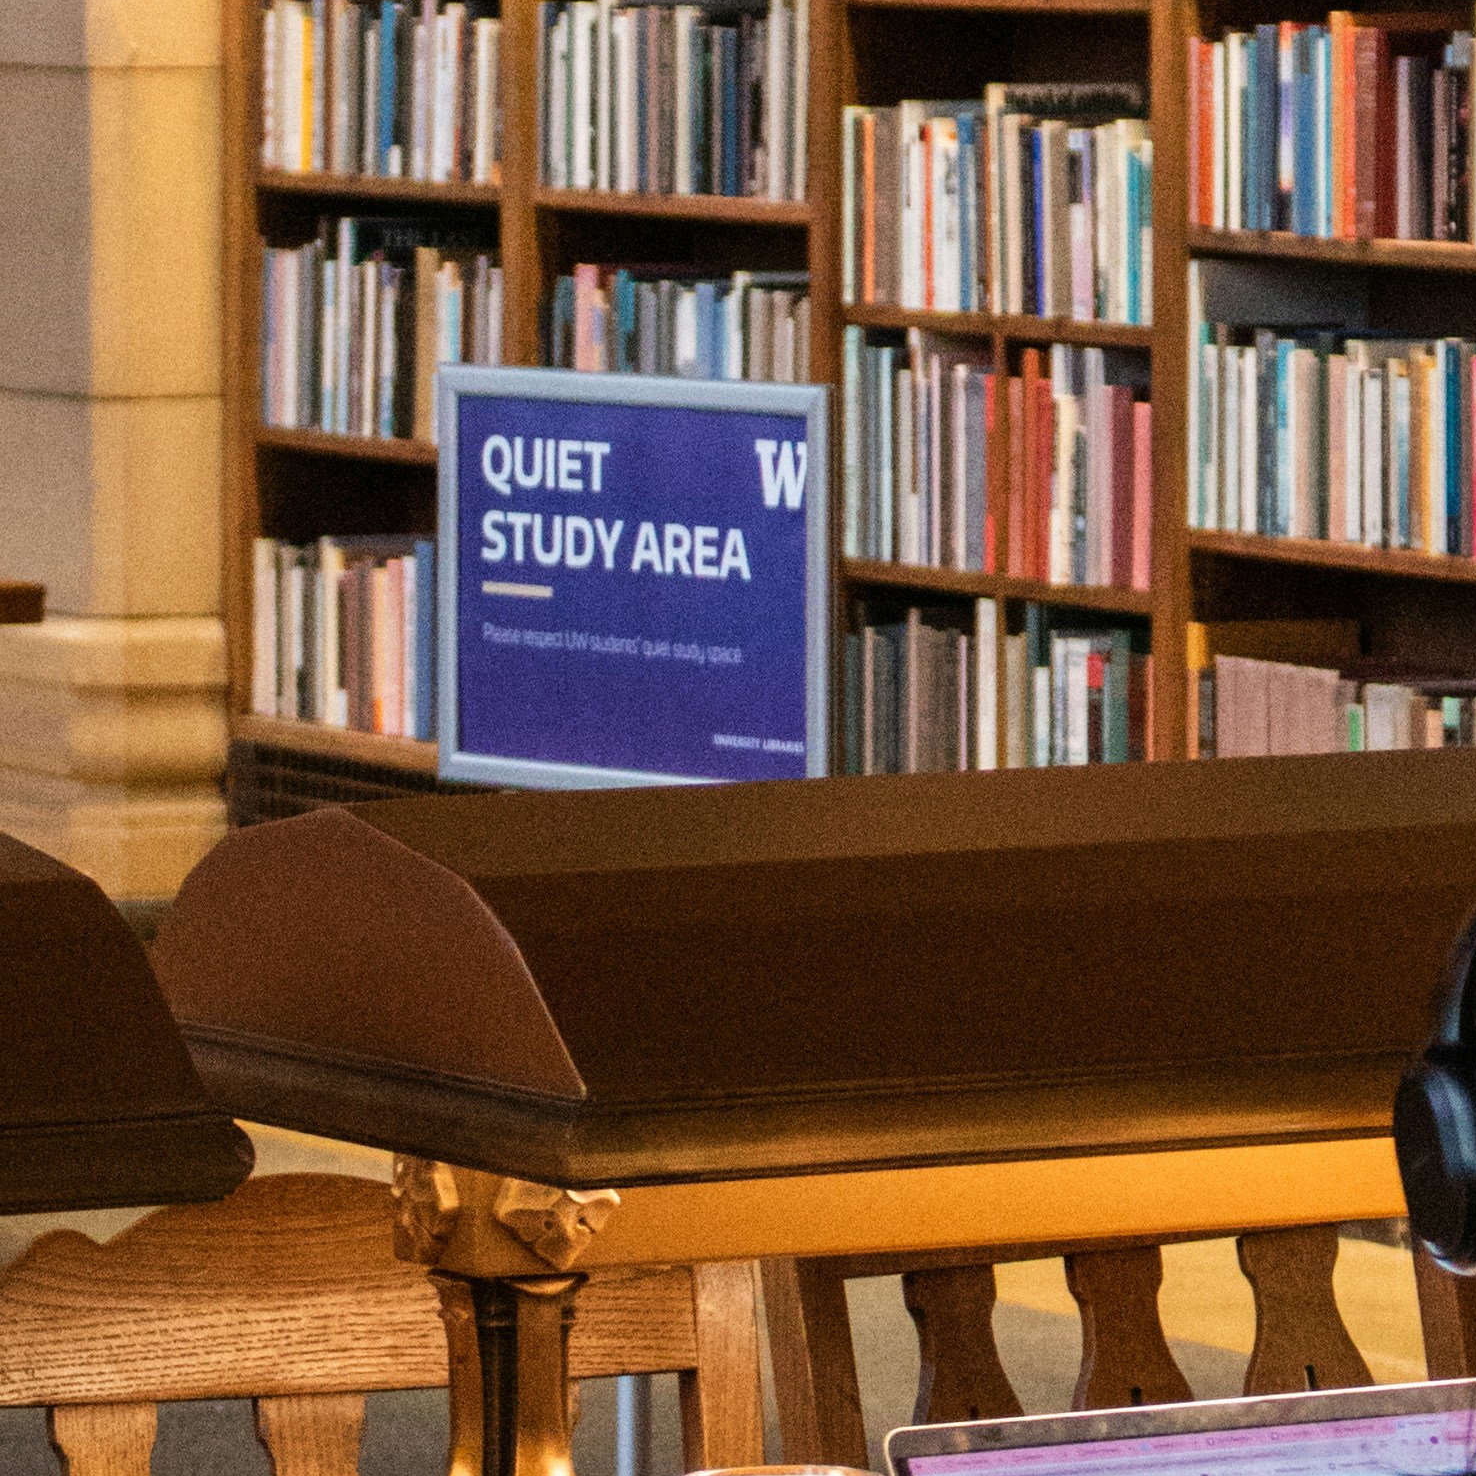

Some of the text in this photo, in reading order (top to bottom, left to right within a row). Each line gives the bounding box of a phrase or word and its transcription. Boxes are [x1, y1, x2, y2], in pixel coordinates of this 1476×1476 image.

[481, 434, 611, 495] QUIET
[755, 438, 807, 510] W
[481, 510, 752, 581] STUDY AREA
[482, 621, 521, 645] Please
[564, 630, 589, 650] UW
[762, 737, 805, 753] LIBRARIES
